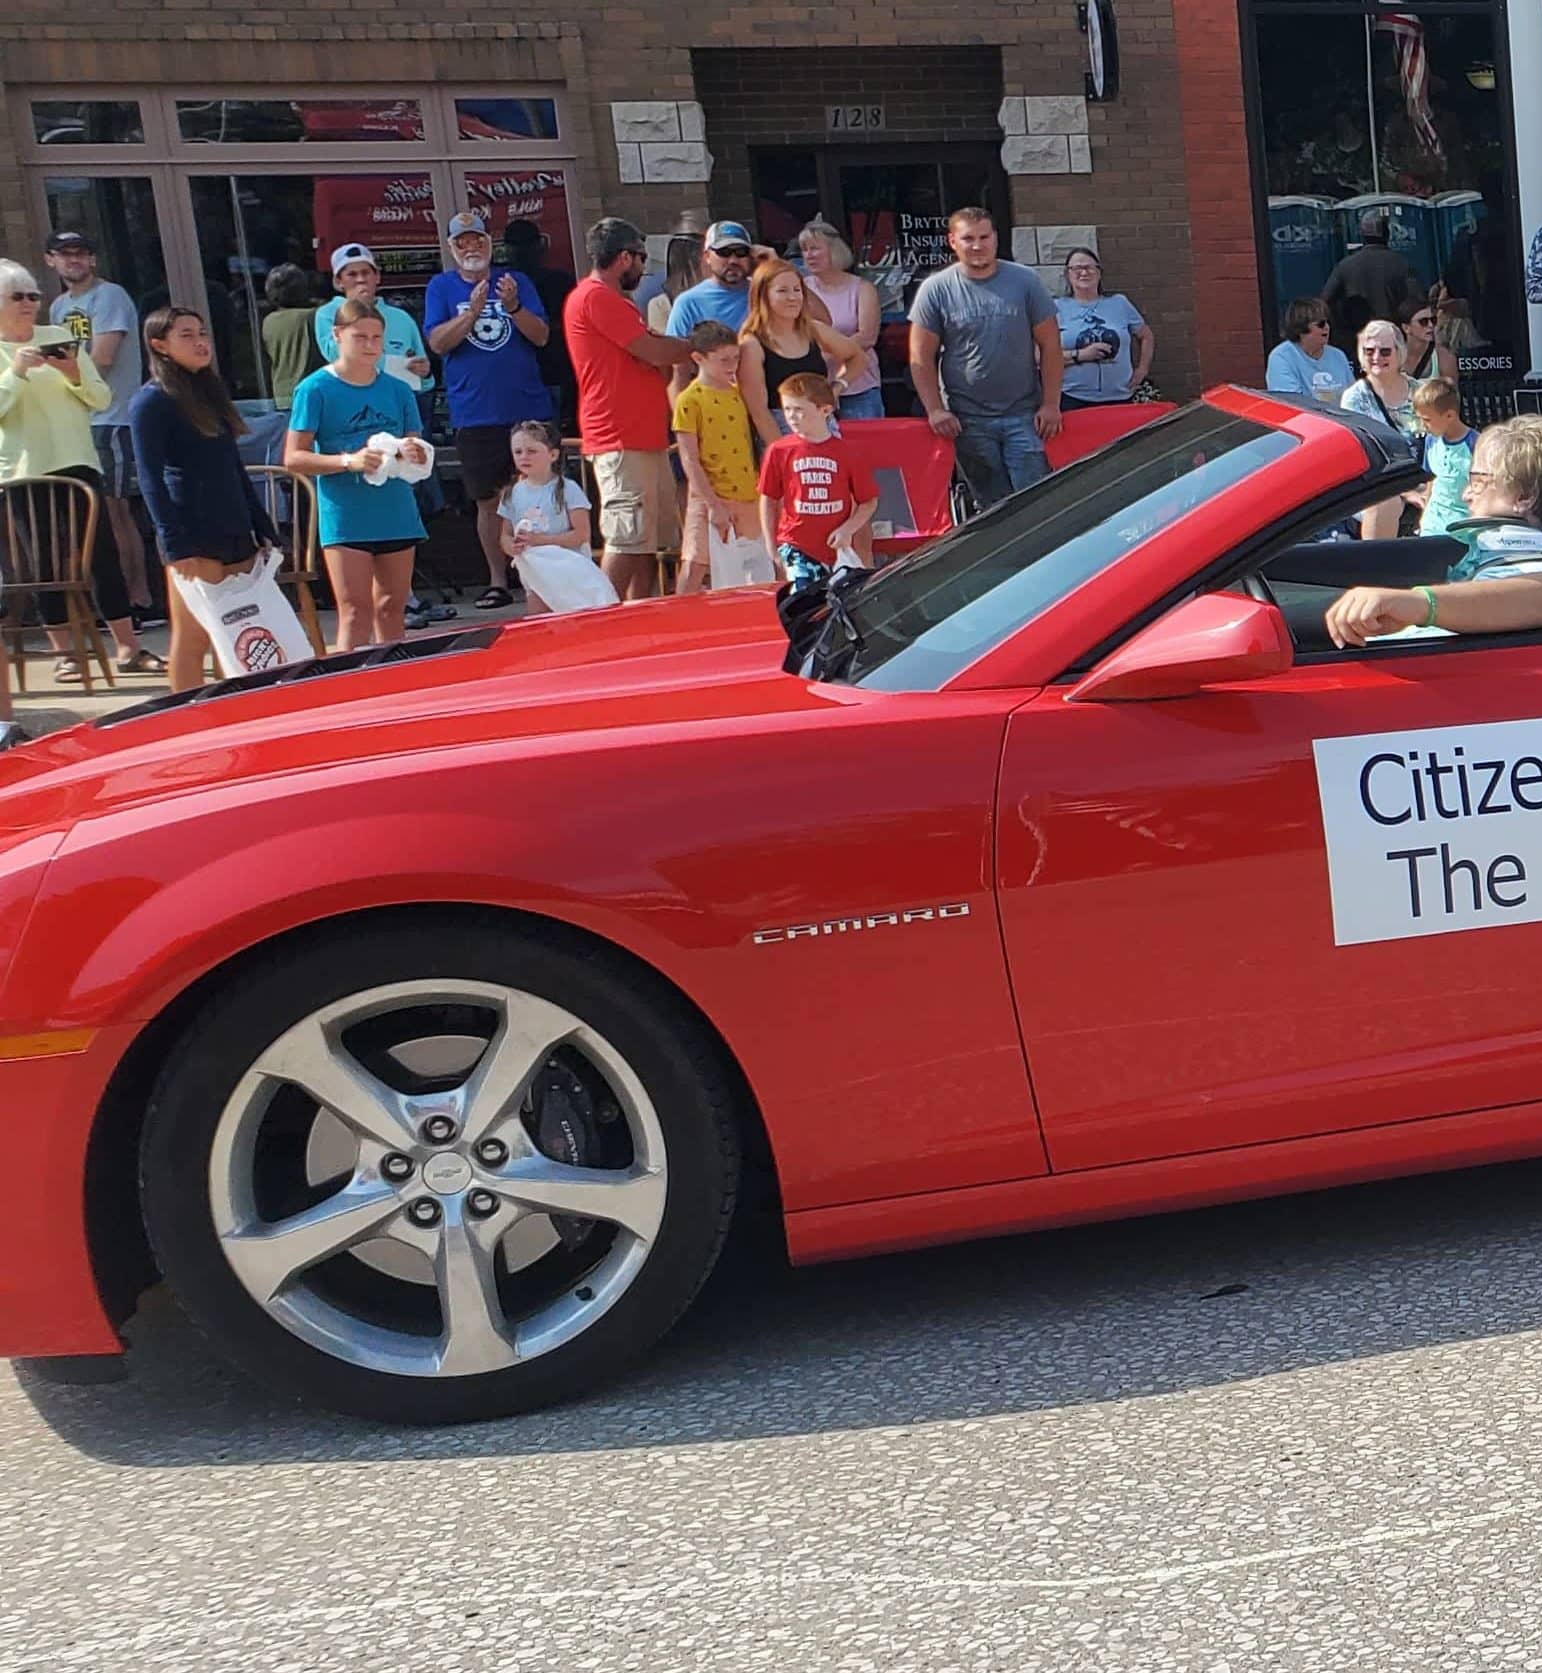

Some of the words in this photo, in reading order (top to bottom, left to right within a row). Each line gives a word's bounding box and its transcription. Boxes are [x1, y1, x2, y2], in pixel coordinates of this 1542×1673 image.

[831, 107, 881, 129] 128
[900, 213, 949, 229] BRYTO
[903, 232, 948, 248] INSUR
[1458, 356, 1513, 370] ESSORIES
[801, 471, 832, 485] PARKS
[808, 487, 828, 500] AND
[1386, 842, 1527, 918] The
[753, 903, 970, 944] CAMARO
